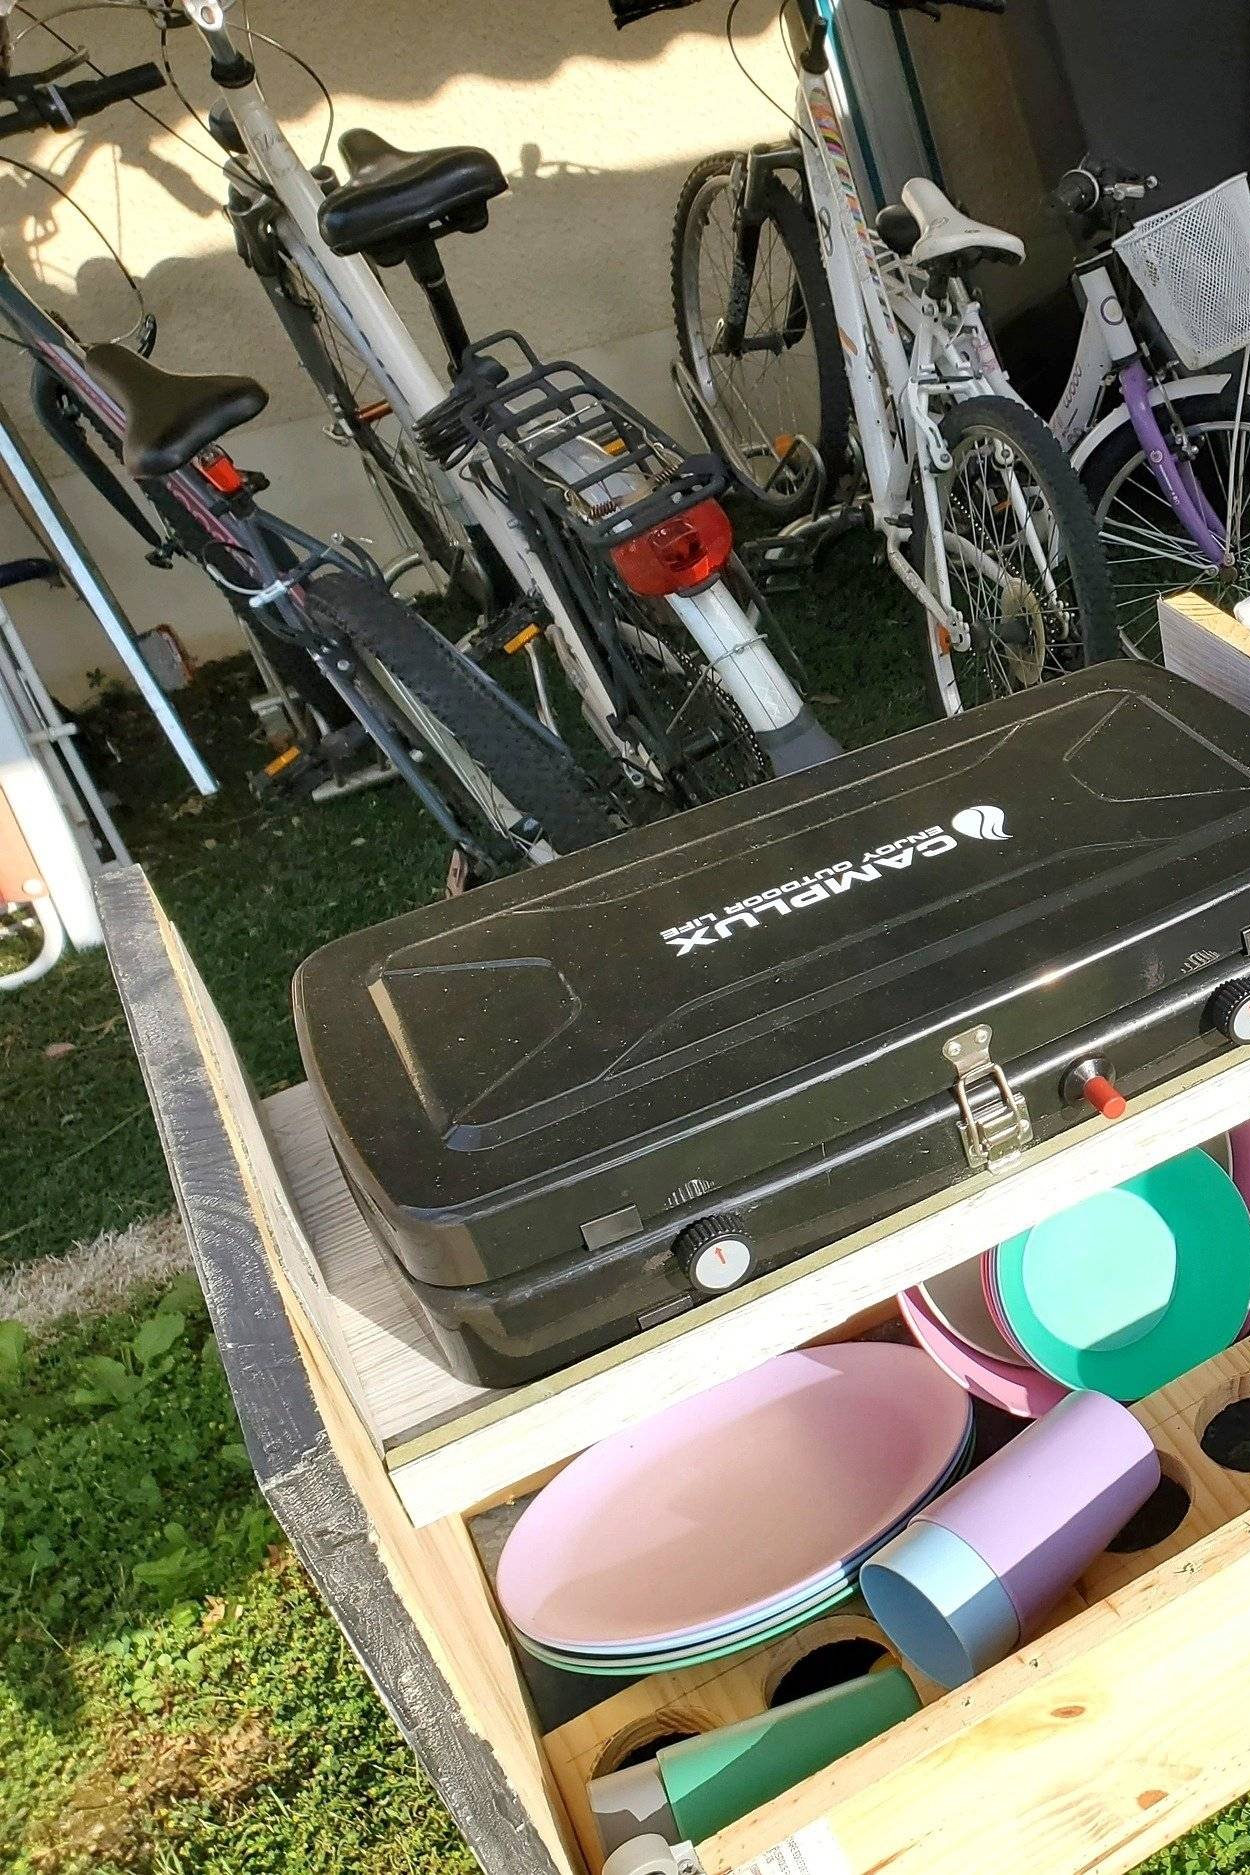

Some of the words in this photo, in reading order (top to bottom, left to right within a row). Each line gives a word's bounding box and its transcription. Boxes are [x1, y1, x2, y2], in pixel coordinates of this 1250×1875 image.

[862, 825, 944, 864] ENJOY
[665, 834, 958, 957] CAMPLUX
[723, 860, 853, 915] OUTDOOR
[659, 912, 718, 940] LIFE
